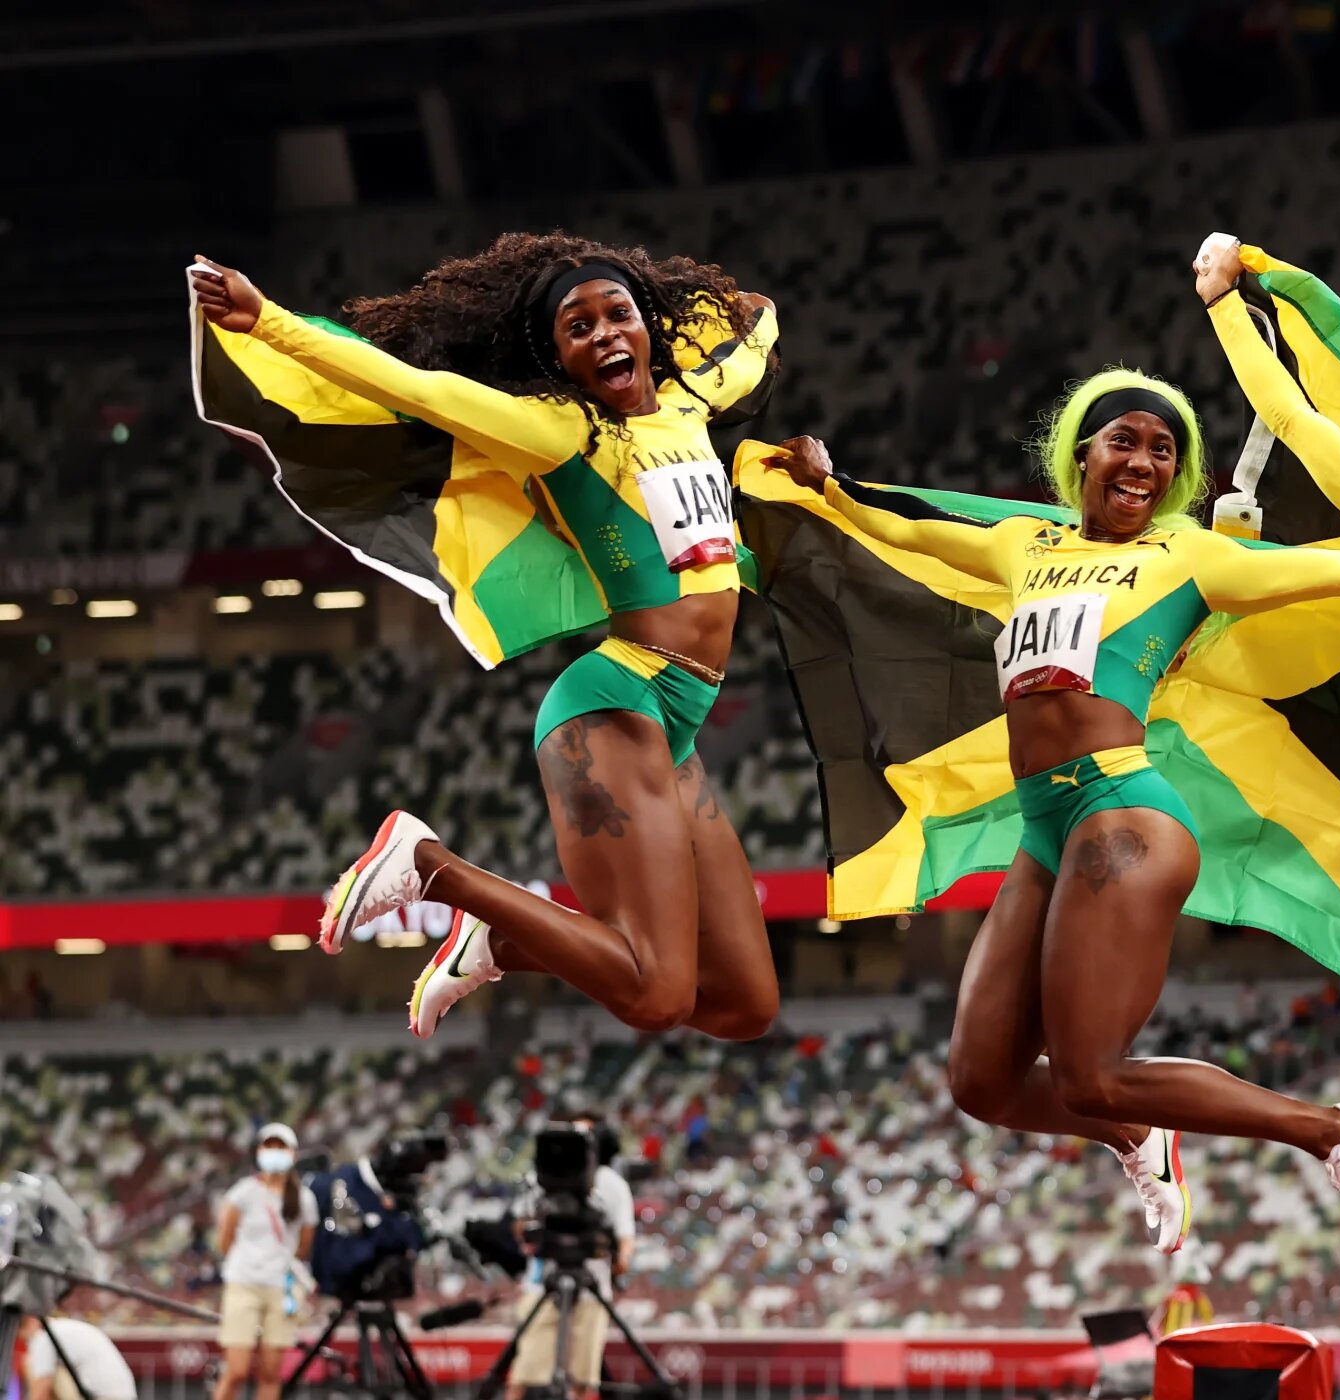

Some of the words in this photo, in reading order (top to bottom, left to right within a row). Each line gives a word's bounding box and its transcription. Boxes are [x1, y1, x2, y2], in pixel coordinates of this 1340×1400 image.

[672, 473, 733, 529] JAM
[1017, 565, 1139, 598] JAMAICA
[1002, 604, 1087, 669] JAM
